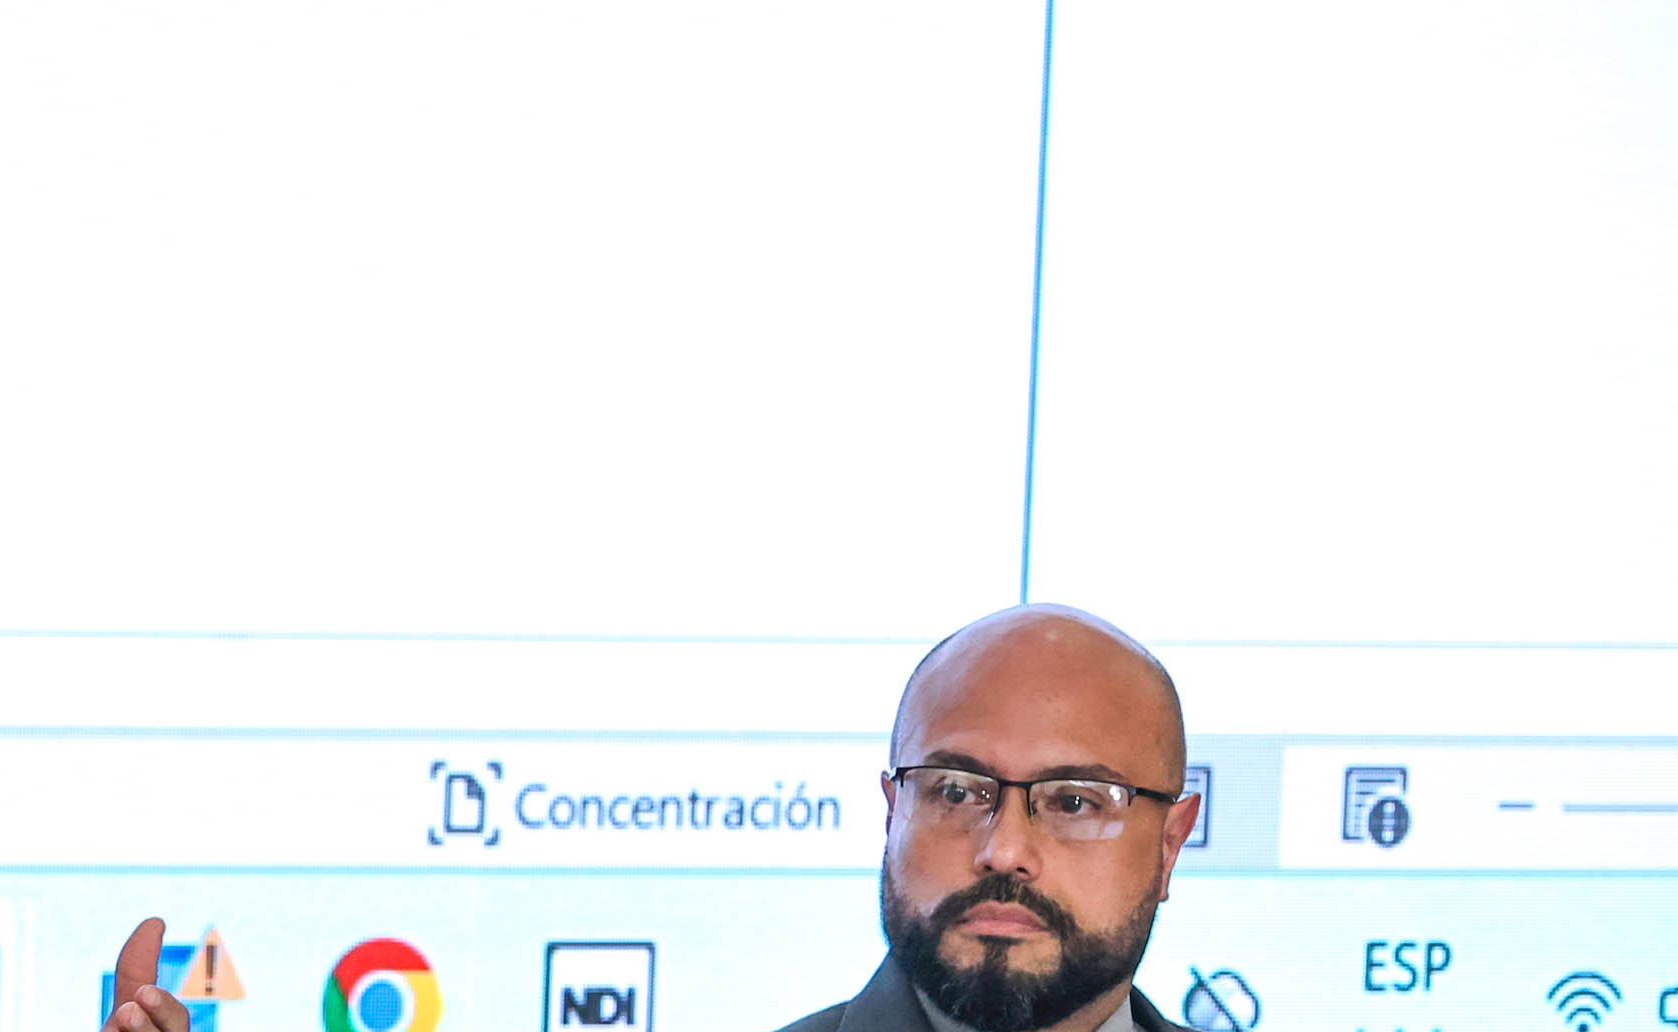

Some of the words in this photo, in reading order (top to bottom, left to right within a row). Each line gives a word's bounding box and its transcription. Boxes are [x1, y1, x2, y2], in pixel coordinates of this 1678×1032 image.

[515, 781, 840, 830] Concentración
[1364, 940, 1453, 992] ESP
[561, 987, 636, 1025] NDI
